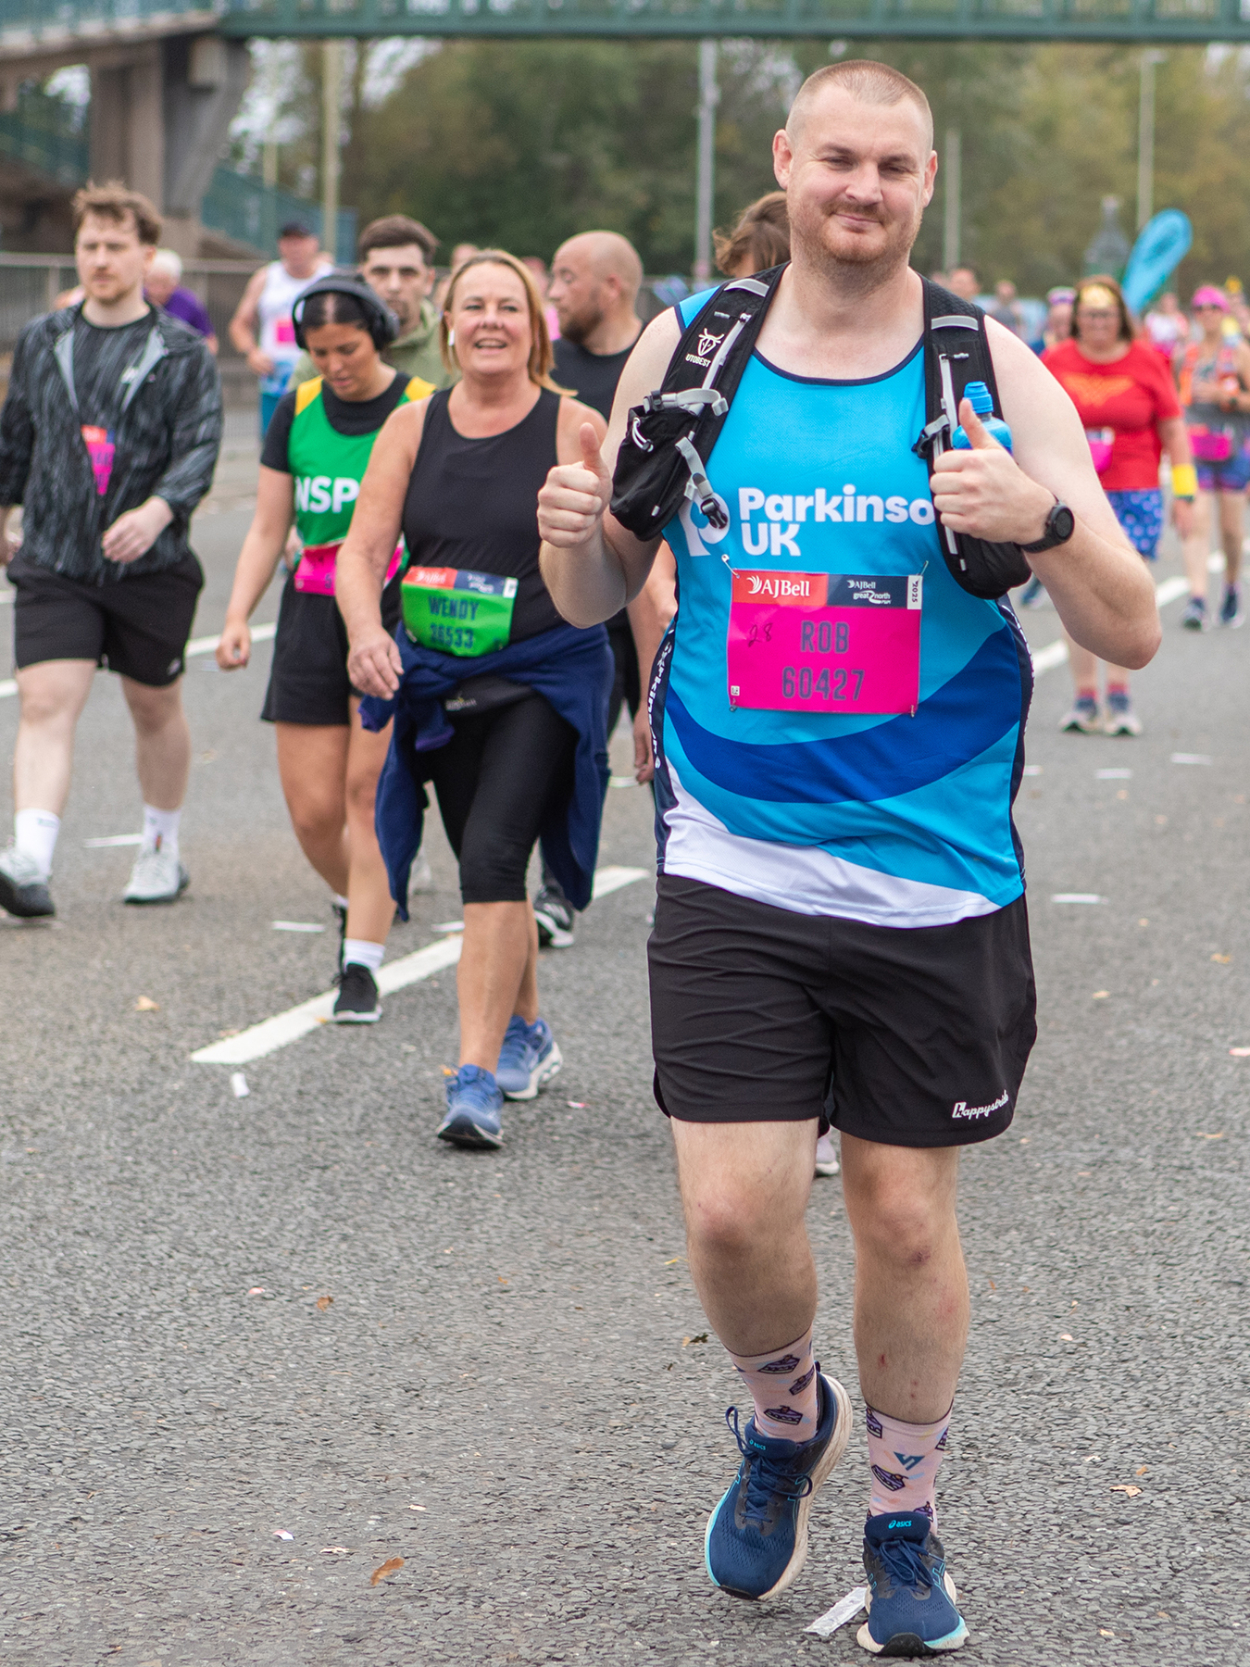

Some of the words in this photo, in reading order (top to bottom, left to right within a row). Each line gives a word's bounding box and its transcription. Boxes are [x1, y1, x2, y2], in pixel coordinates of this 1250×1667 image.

[295, 475, 360, 513] NSP
[738, 484, 935, 525] Parkinso
[741, 523, 801, 556] UK
[428, 596, 480, 621] WENDY
[801, 620, 849, 653] ROB
[782, 666, 865, 701] 60427
